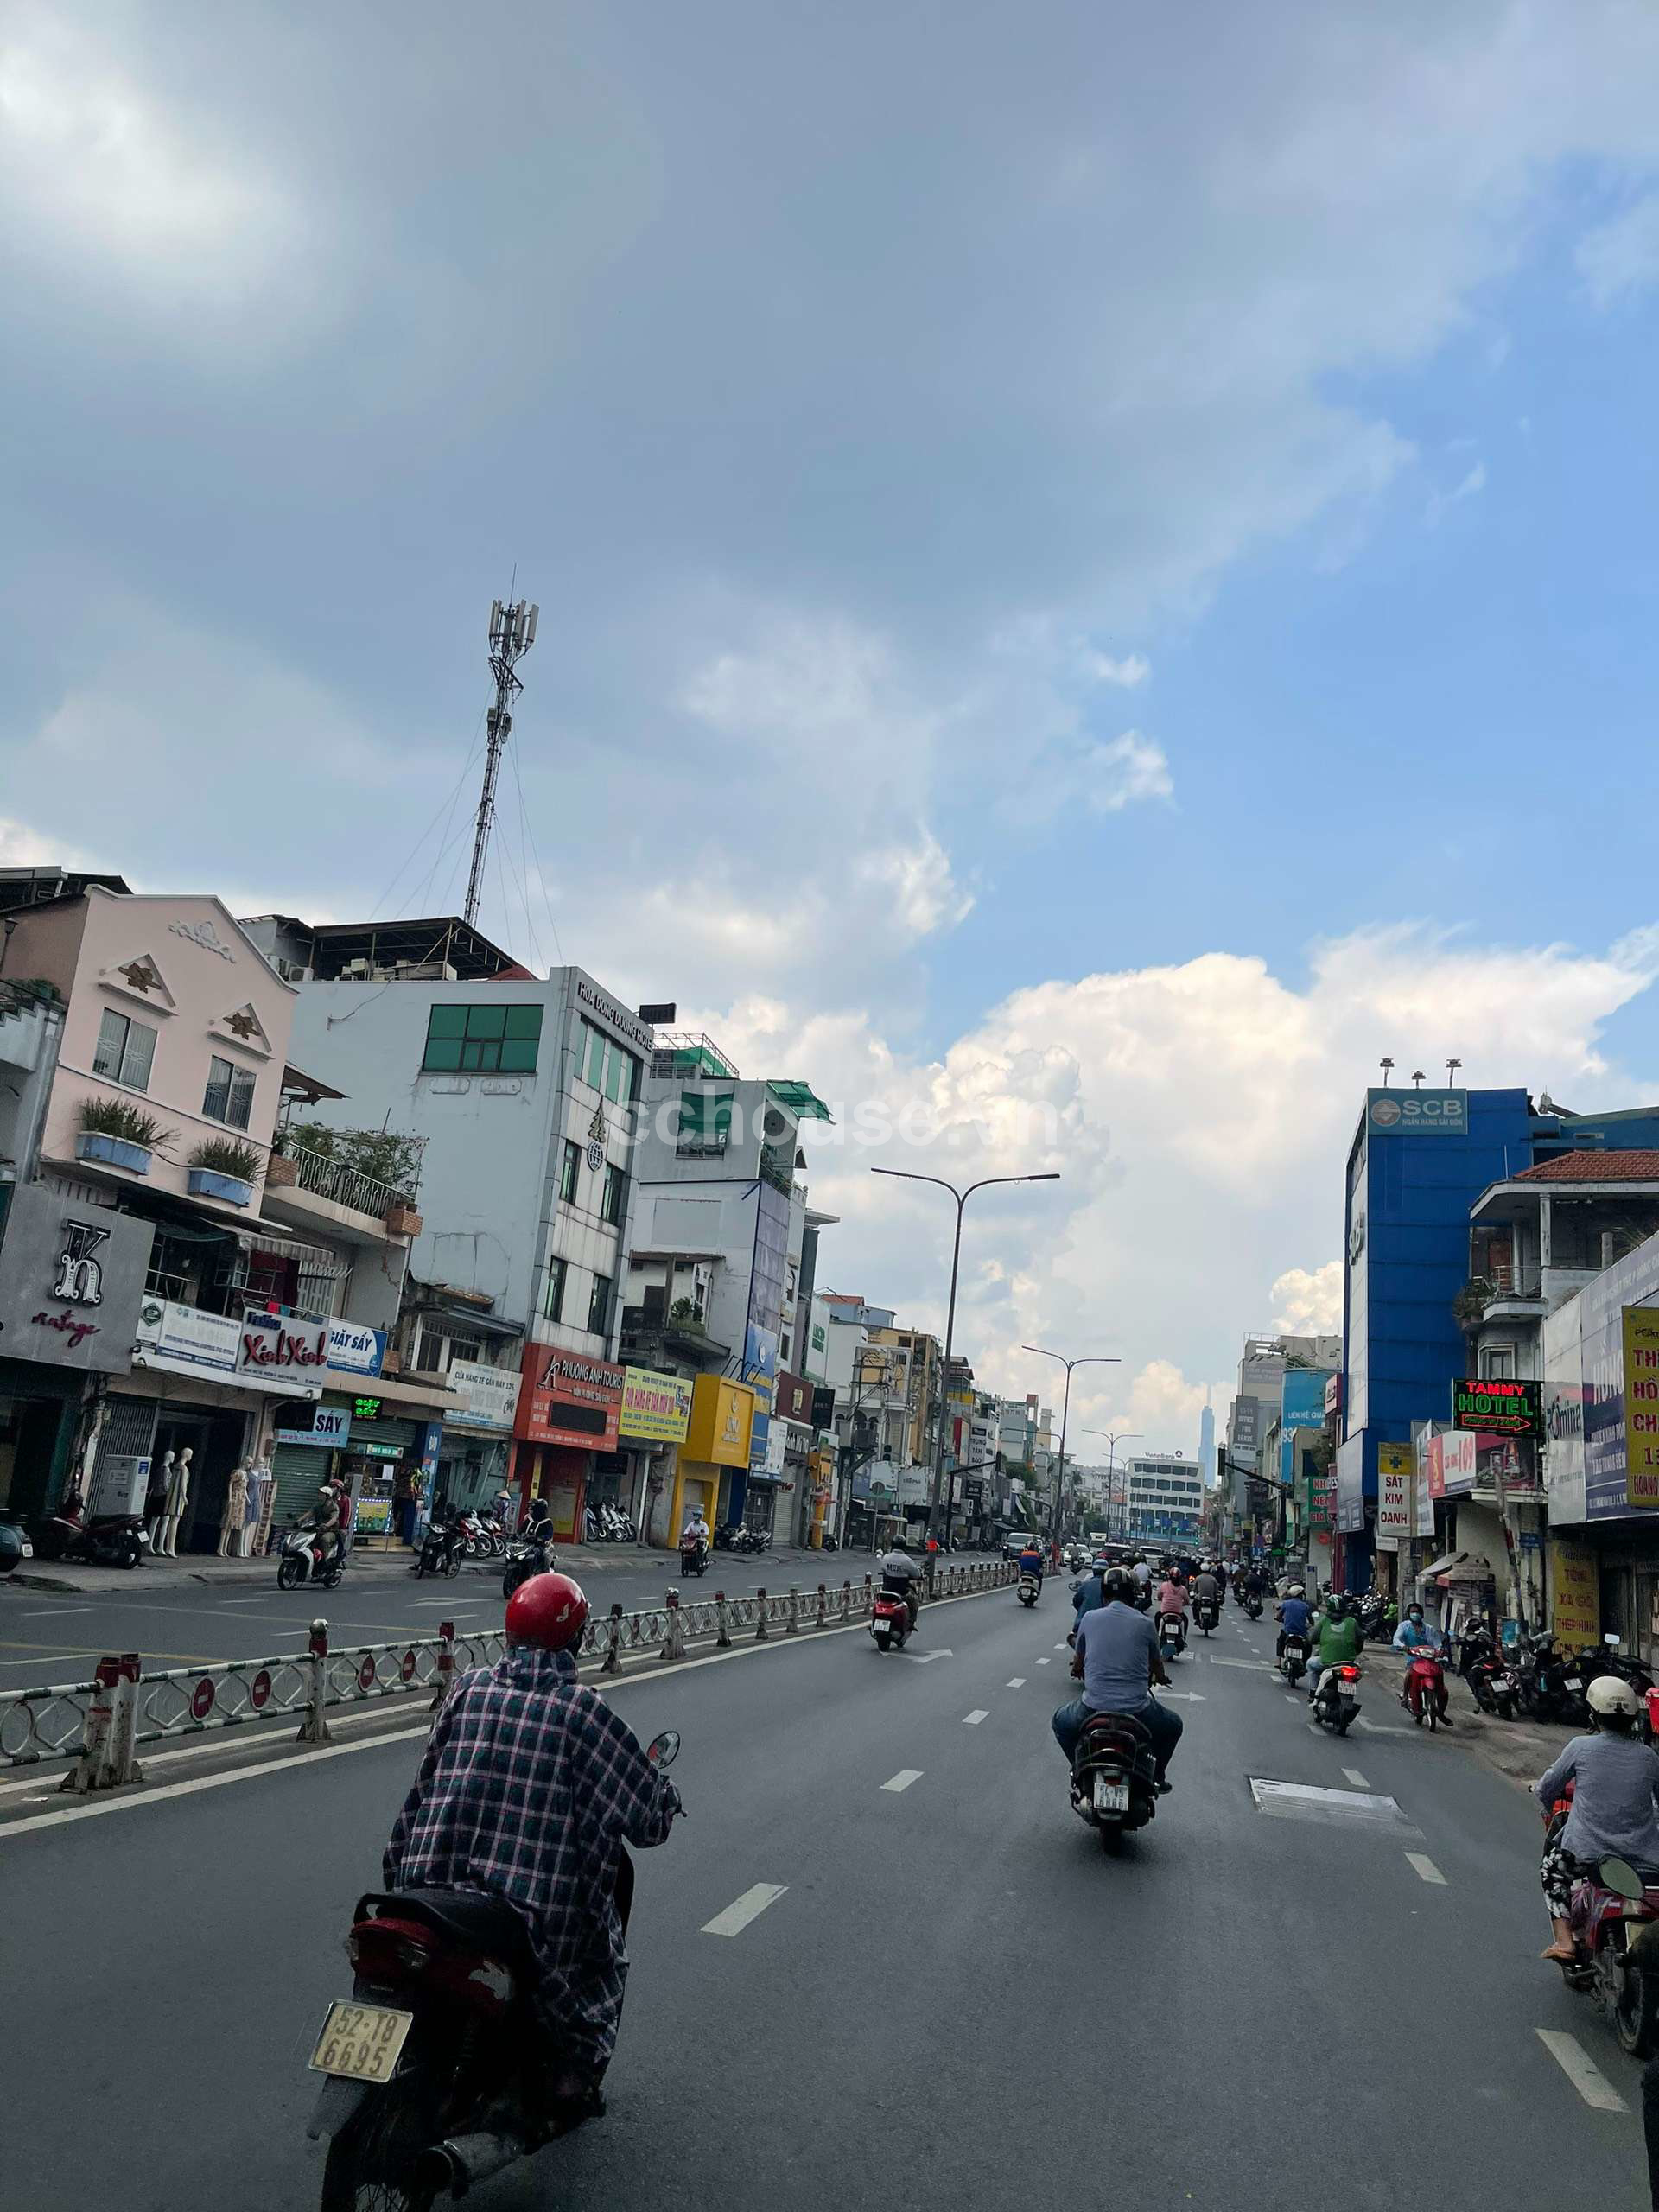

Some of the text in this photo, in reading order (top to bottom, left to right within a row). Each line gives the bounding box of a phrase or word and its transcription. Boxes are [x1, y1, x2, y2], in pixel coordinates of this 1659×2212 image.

[1402, 1099, 1463, 1116] SCB
[351, 1332, 372, 1351] SẤY
[1465, 1381, 1525, 1397] TAMMY
[1459, 1394, 1533, 1416] HOTEL
[315, 1409, 343, 1433] SẤY
[1385, 1492, 1403, 1505] KIM
[1381, 1511, 1408, 1524] OANH
